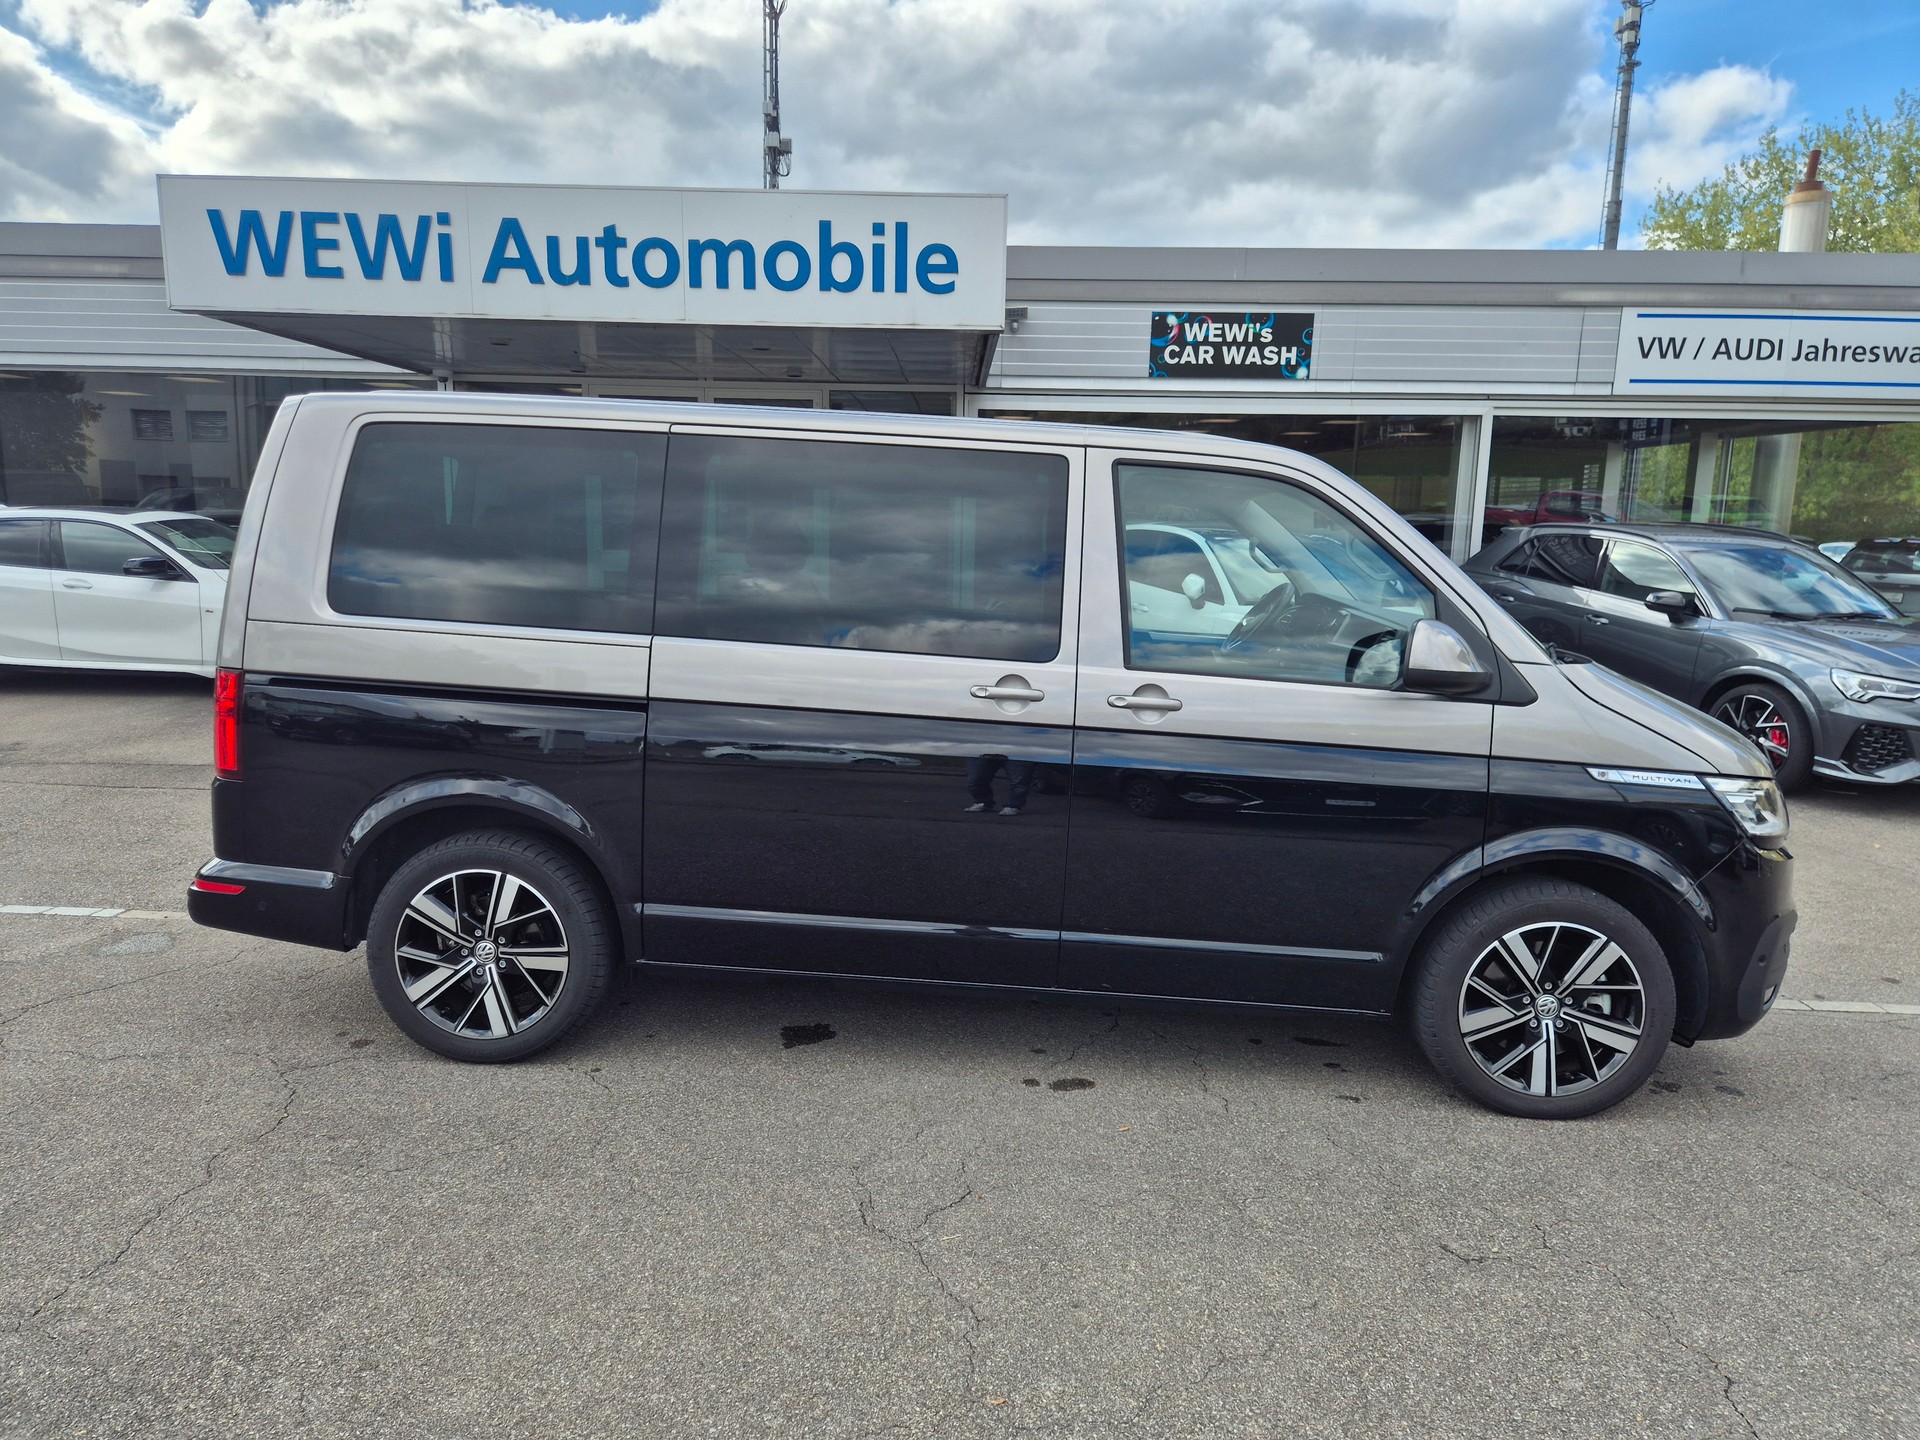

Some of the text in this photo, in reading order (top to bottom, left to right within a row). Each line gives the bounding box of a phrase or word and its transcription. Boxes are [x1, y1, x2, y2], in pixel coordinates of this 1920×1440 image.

[206, 208, 960, 294] WEWi Automobile
[1184, 322, 1273, 342] WEWi's
[1164, 345, 1298, 365] CAR WASH
[1637, 336, 1920, 363] VW / AUDI Jahreswa
[1632, 774, 1691, 784] MULTIVAN
